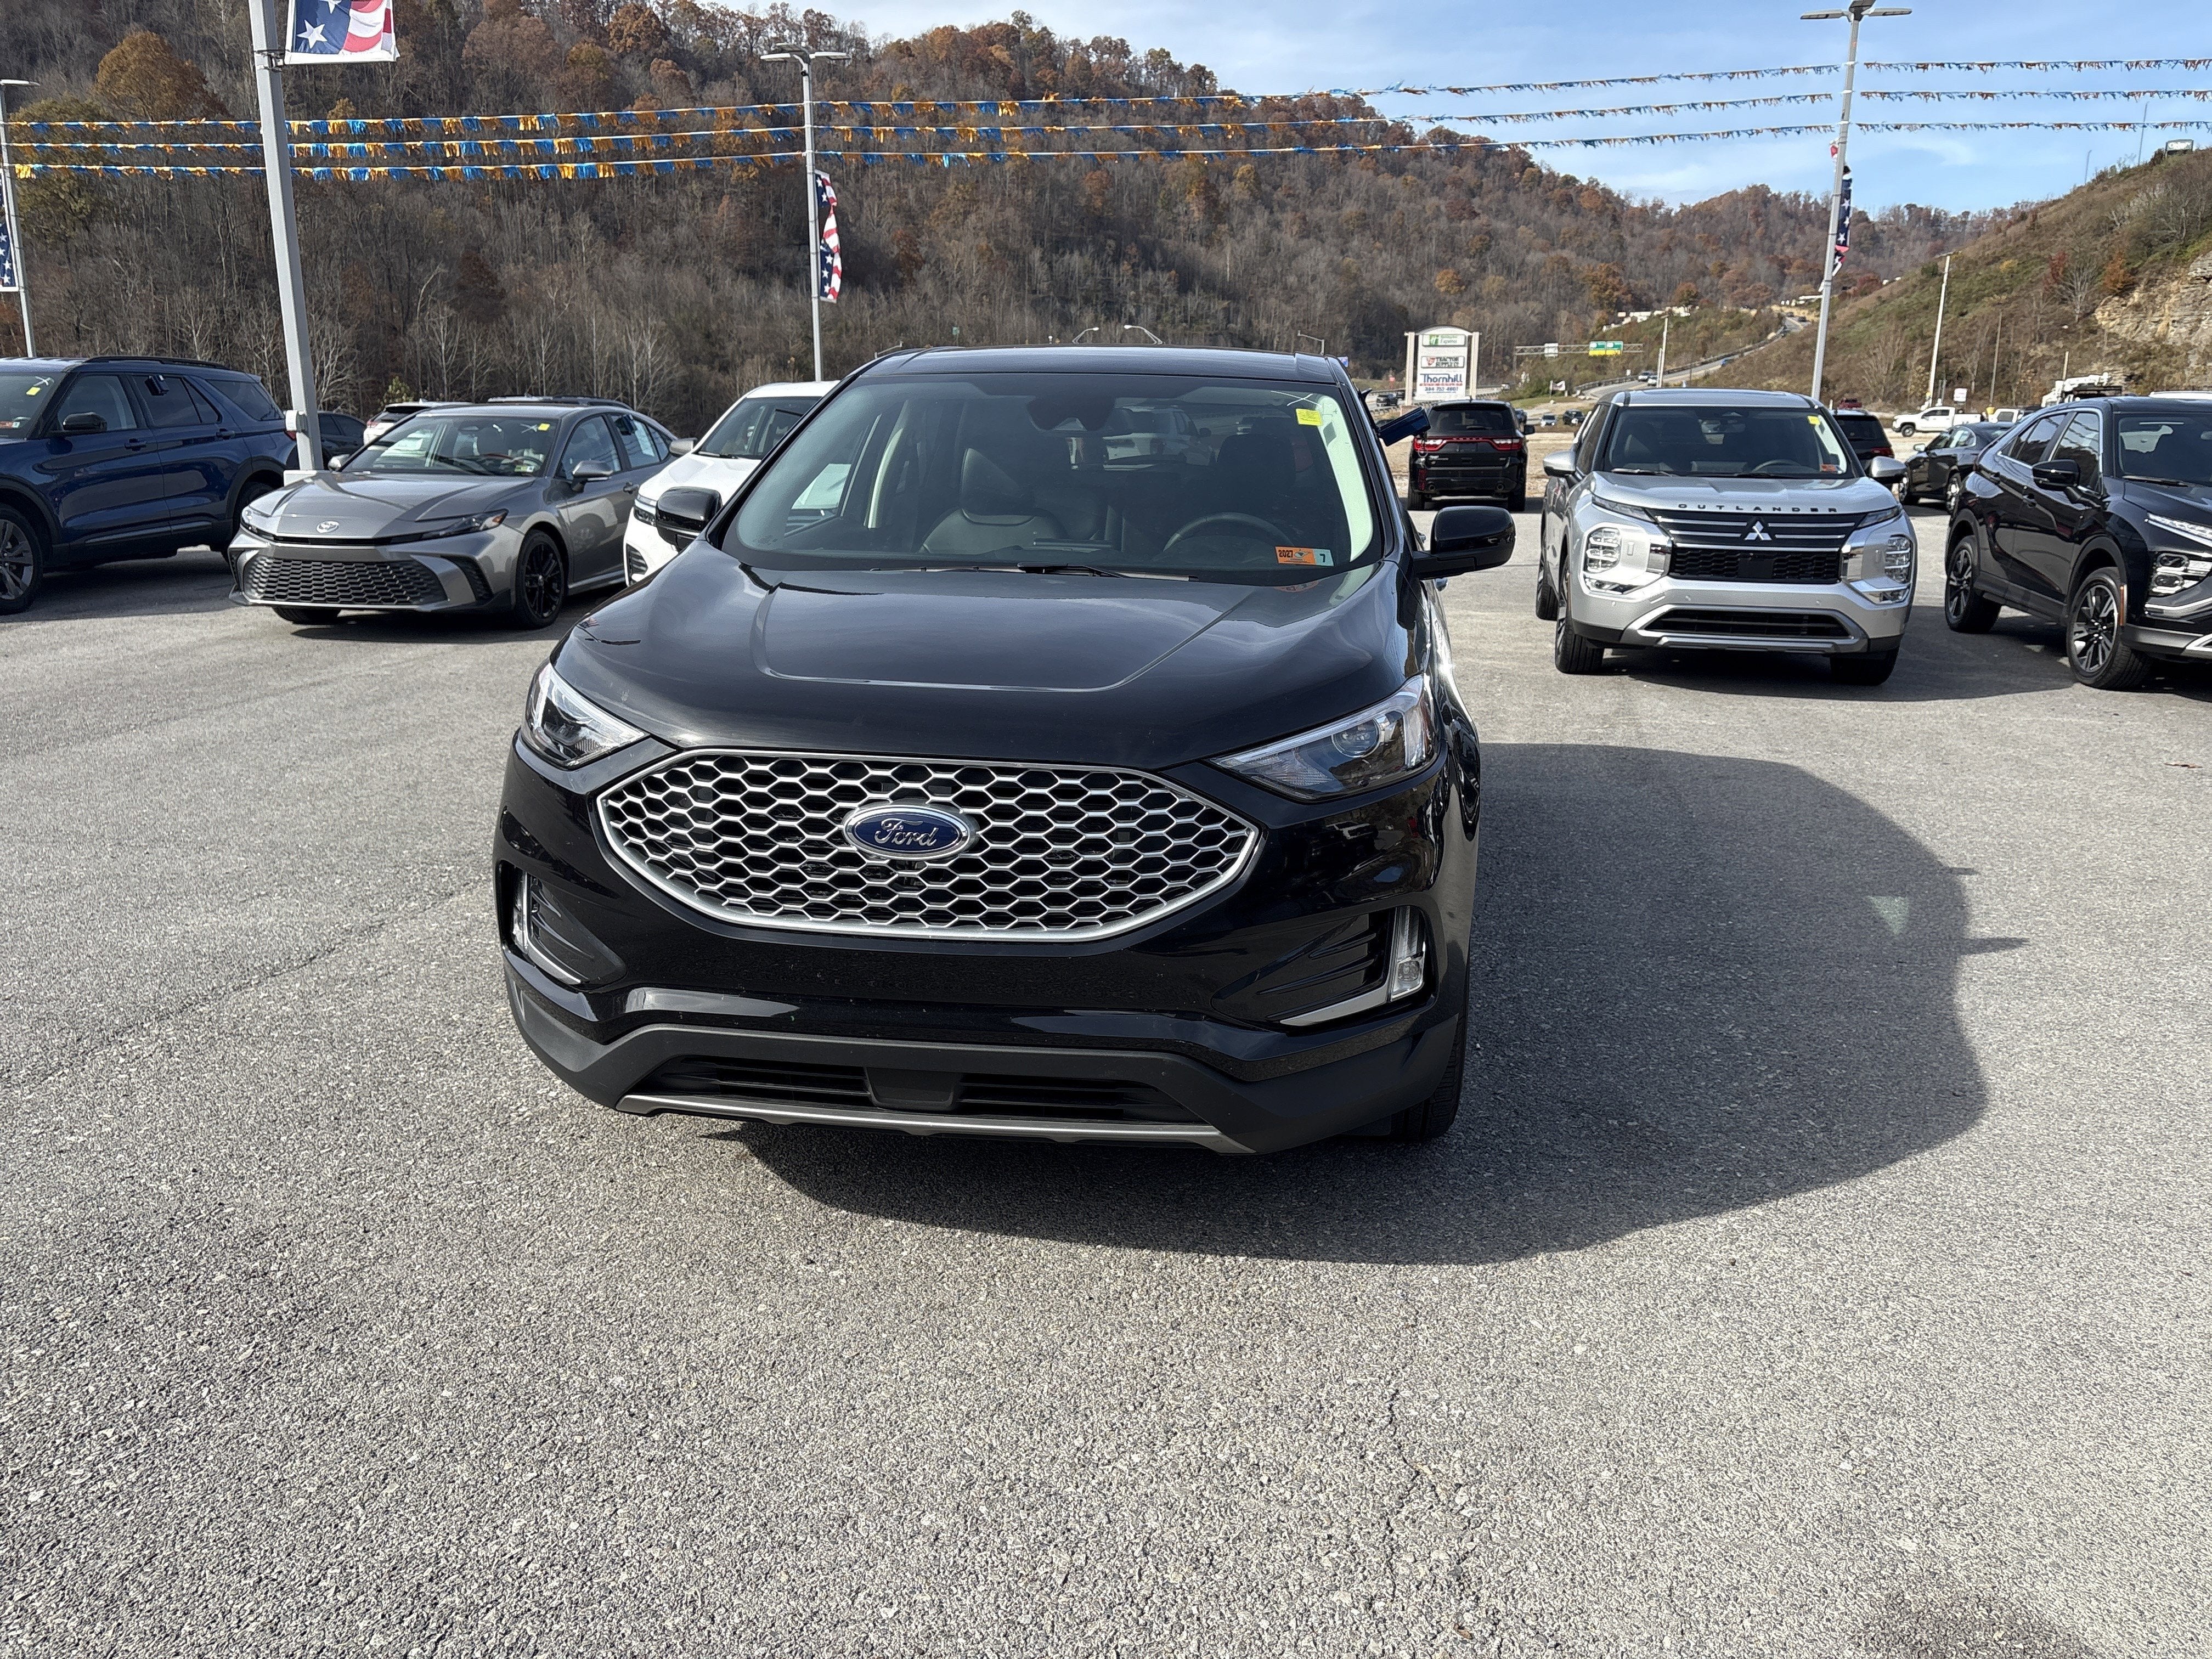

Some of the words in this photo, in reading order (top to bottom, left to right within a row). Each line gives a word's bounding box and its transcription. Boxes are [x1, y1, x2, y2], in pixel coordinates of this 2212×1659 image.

[1420, 374, 1463, 382] Thornhill
[1678, 503, 1837, 513] OUTLANDER
[1278, 549, 1294, 558] 2027
[1319, 553, 1326, 563] 7
[874, 818, 939, 847] Ford
